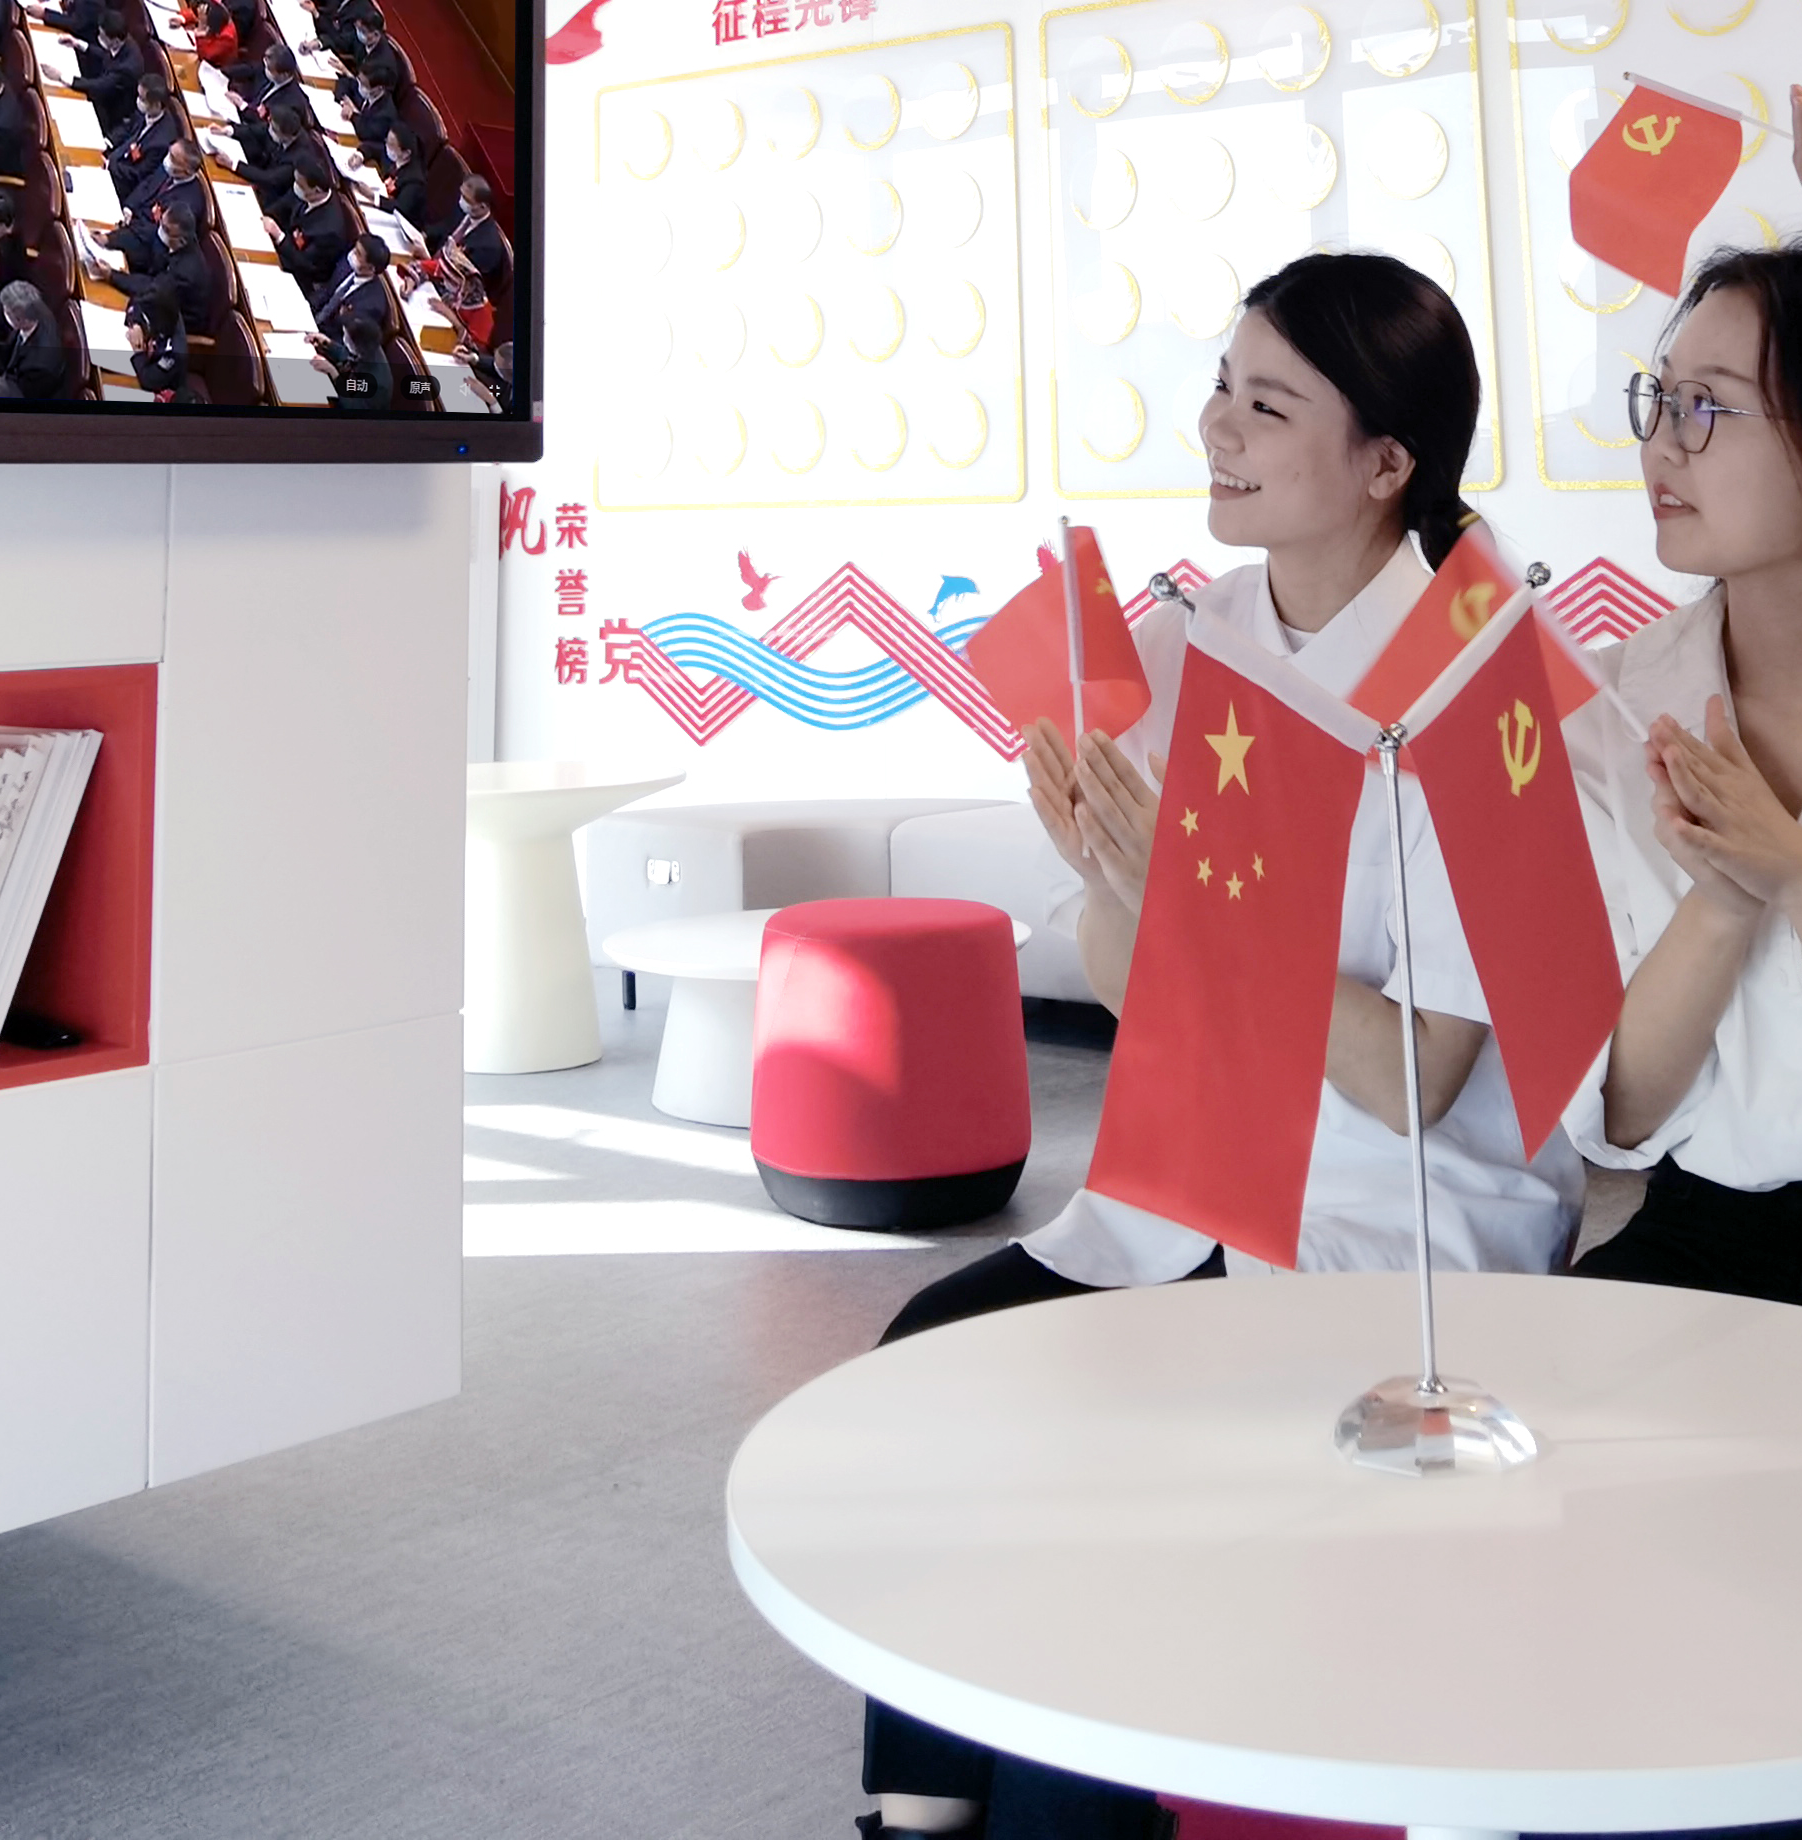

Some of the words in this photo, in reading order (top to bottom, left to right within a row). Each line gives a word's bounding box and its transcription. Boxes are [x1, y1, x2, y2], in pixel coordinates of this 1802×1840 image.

[346, 378, 369, 393] 自动
[409, 381, 432, 395] 原声
[554, 503, 589, 685] 荣誉榜
